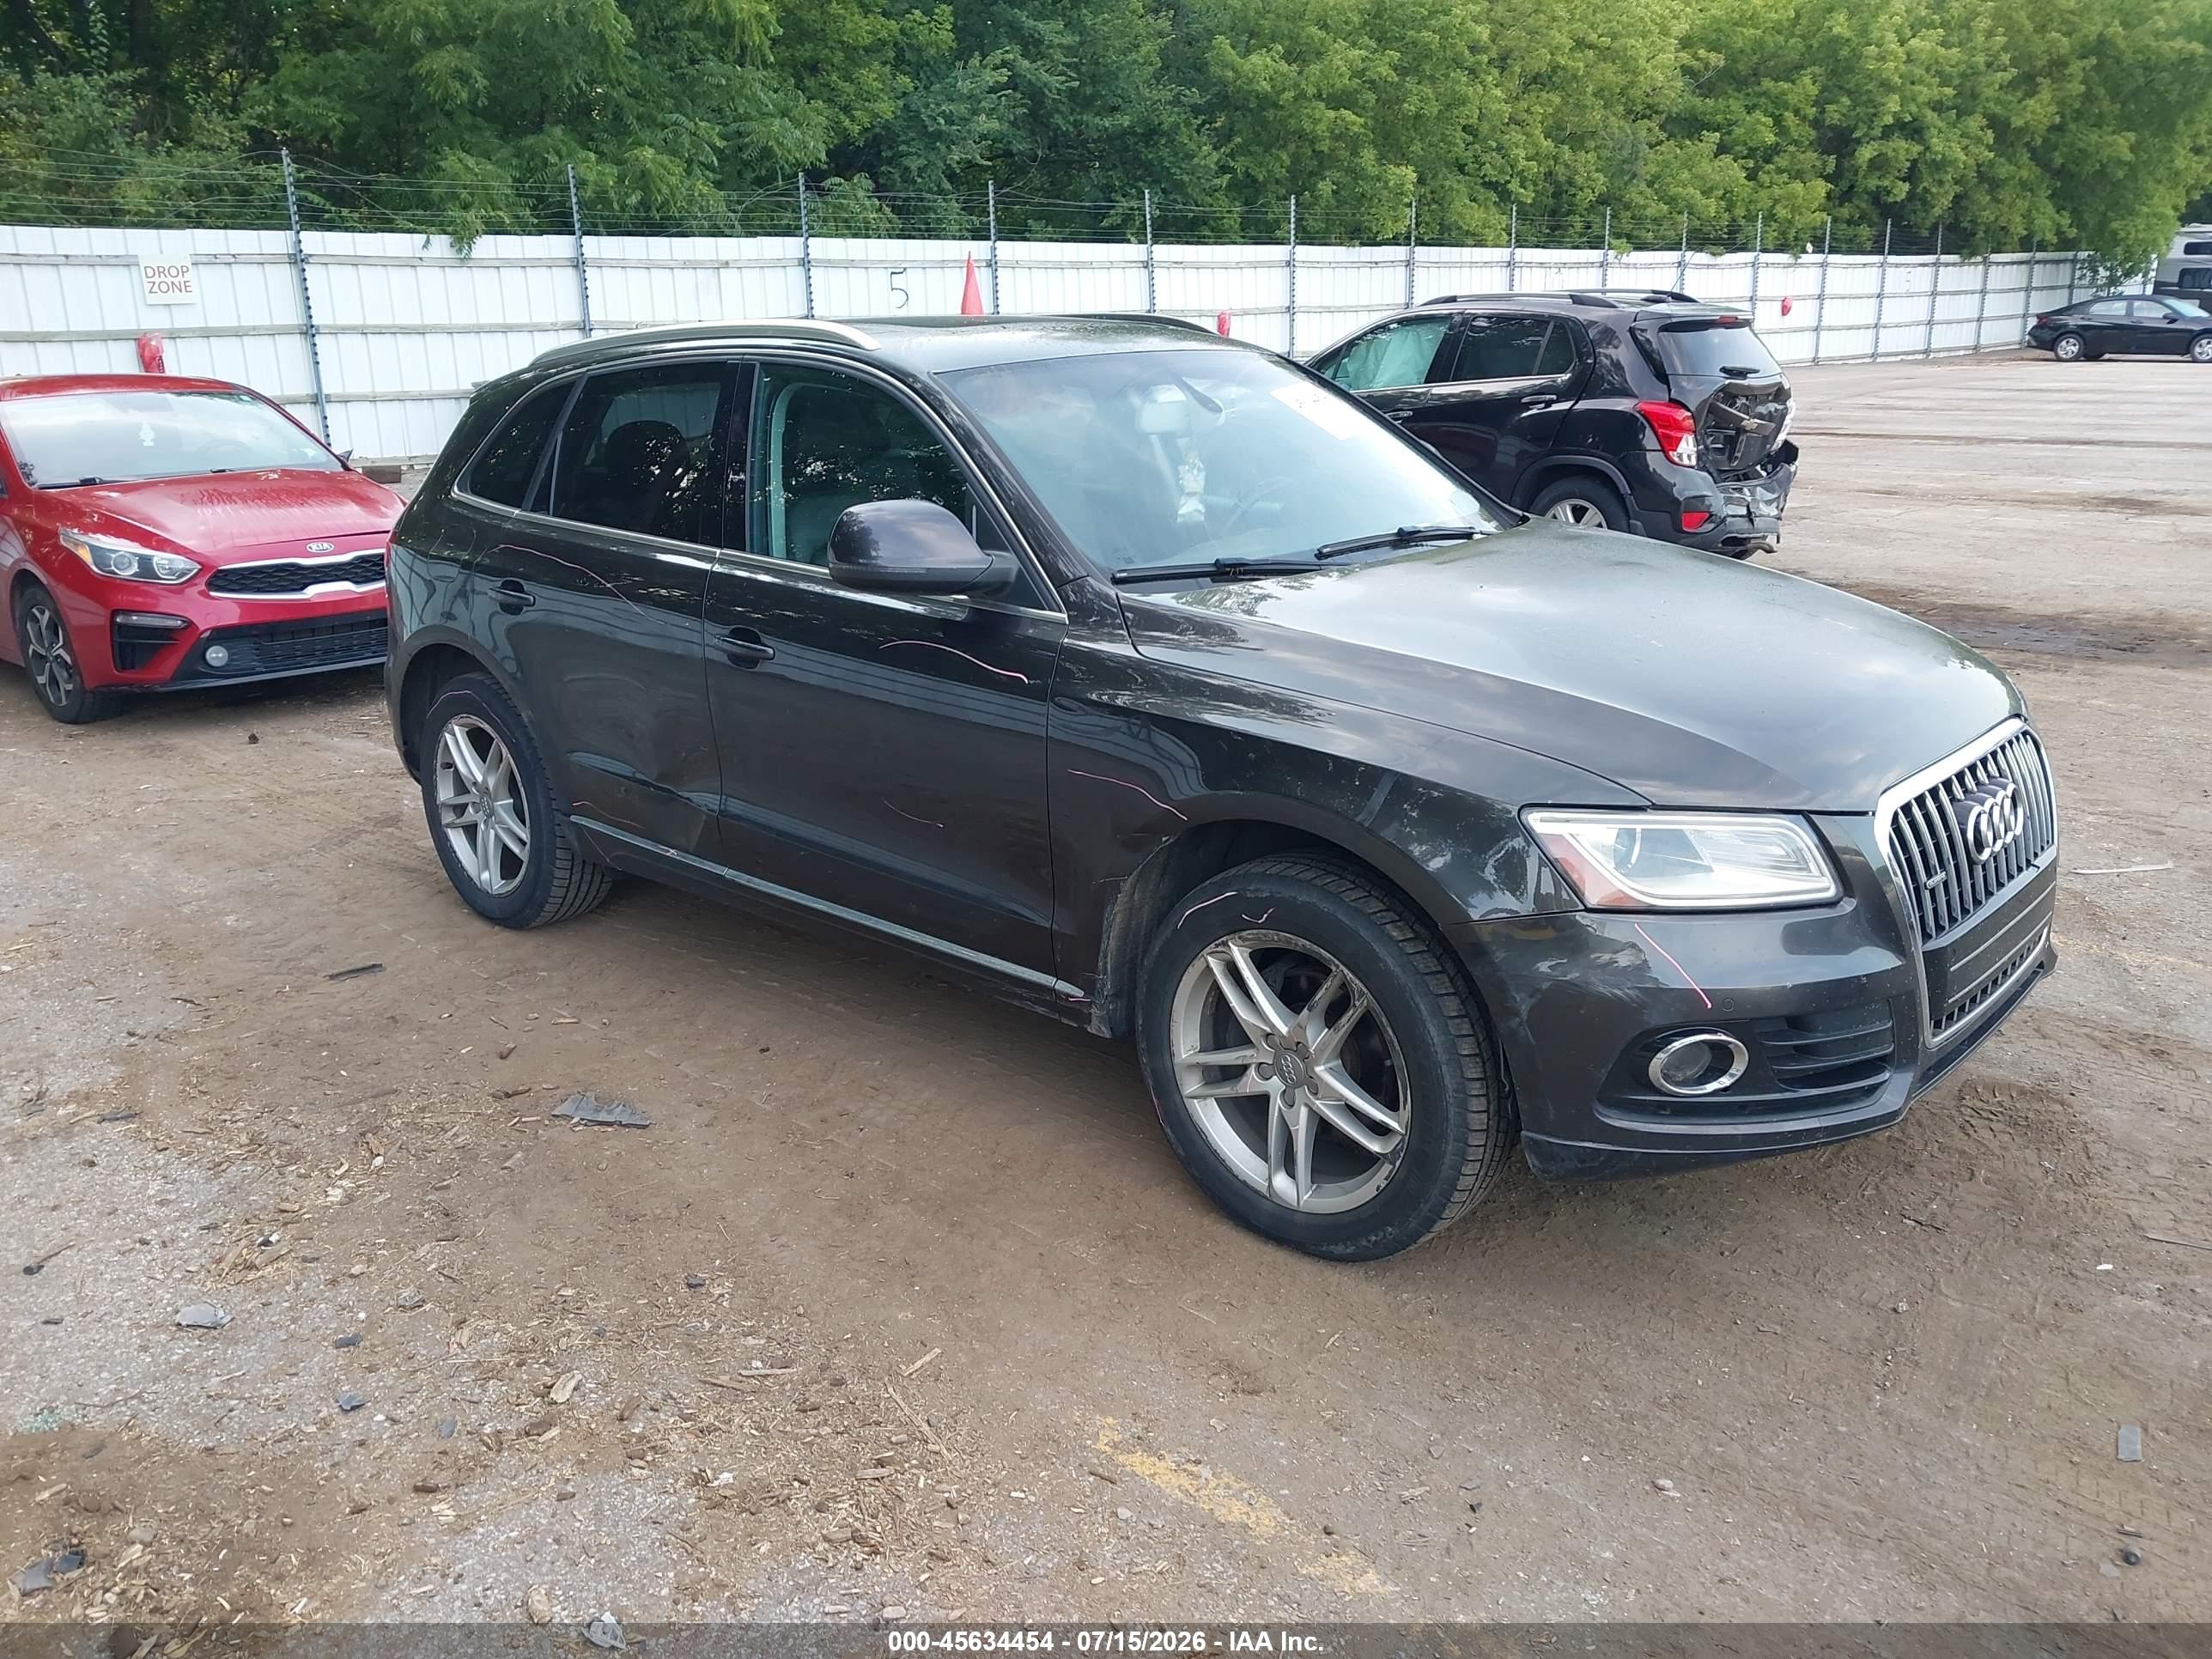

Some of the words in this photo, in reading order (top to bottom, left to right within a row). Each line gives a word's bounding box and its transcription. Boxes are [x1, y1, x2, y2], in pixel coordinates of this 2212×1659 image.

[143, 264, 190, 279] DROP
[146, 280, 193, 295] ZONE
[890, 267, 909, 309] 5
